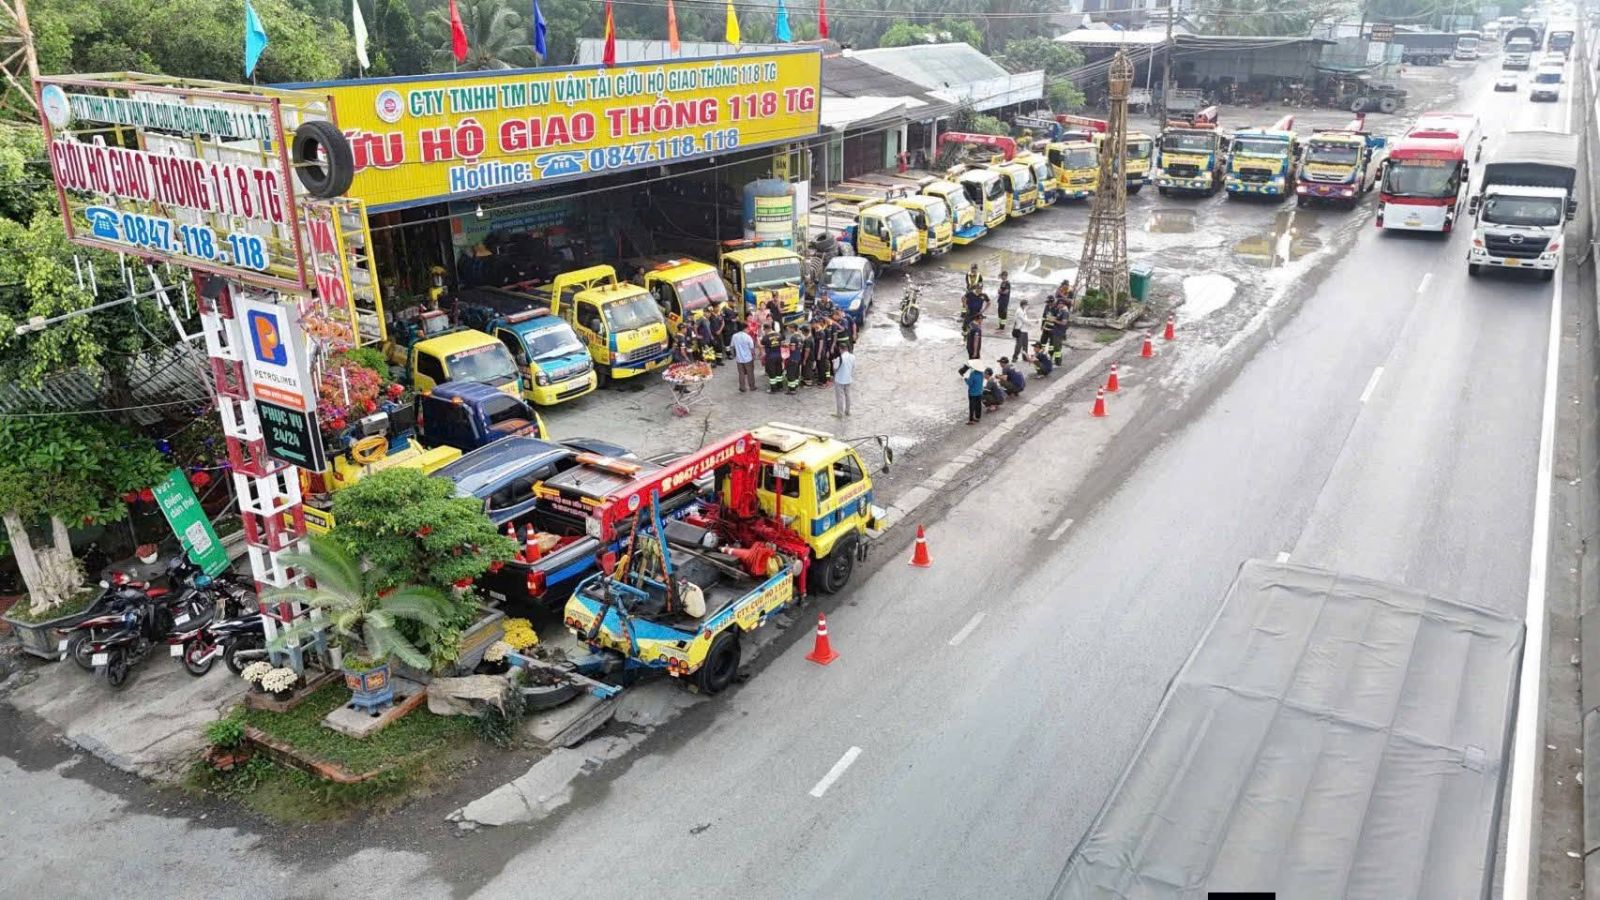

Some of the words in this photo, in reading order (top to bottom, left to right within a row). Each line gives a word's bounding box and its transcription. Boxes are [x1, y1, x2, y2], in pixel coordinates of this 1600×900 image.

[410, 91, 444, 116] CTY
[451, 86, 496, 112] TNHH
[501, 83, 526, 107] TM
[532, 81, 550, 103] DV
[556, 75, 585, 105] VẬN
[590, 69, 611, 98] TẢI
[617, 72, 642, 96] CỨU
[648, 67, 665, 97] HỘ
[670, 70, 697, 90] GIAO
[700, 64, 737, 85] THÔNG
[741, 63, 760, 80] 118
[764, 63, 777, 80] TG
[257, 114, 271, 140] TG
[343, 129, 404, 171] ỨU
[421, 118, 484, 163] HỘ
[500, 113, 595, 152] GIAO
[607, 98, 718, 137] THÔNG
[729, 92, 777, 120] 118
[785, 87, 815, 112] TG
[53, 133, 87, 190] CỨU
[85, 138, 110, 204] HỘ
[109, 149, 149, 200] GIAO
[148, 147, 210, 211] THÔNG
[253, 169, 283, 222] TG
[451, 163, 531, 192] Hotline:
[589, 128, 739, 170] 0847.118.118
[254, 369, 297, 387] PETROLIMEX
[261, 405, 289, 426] PHỤC
[288, 412, 304, 432] VỤ
[273, 427, 300, 447] 24/24
